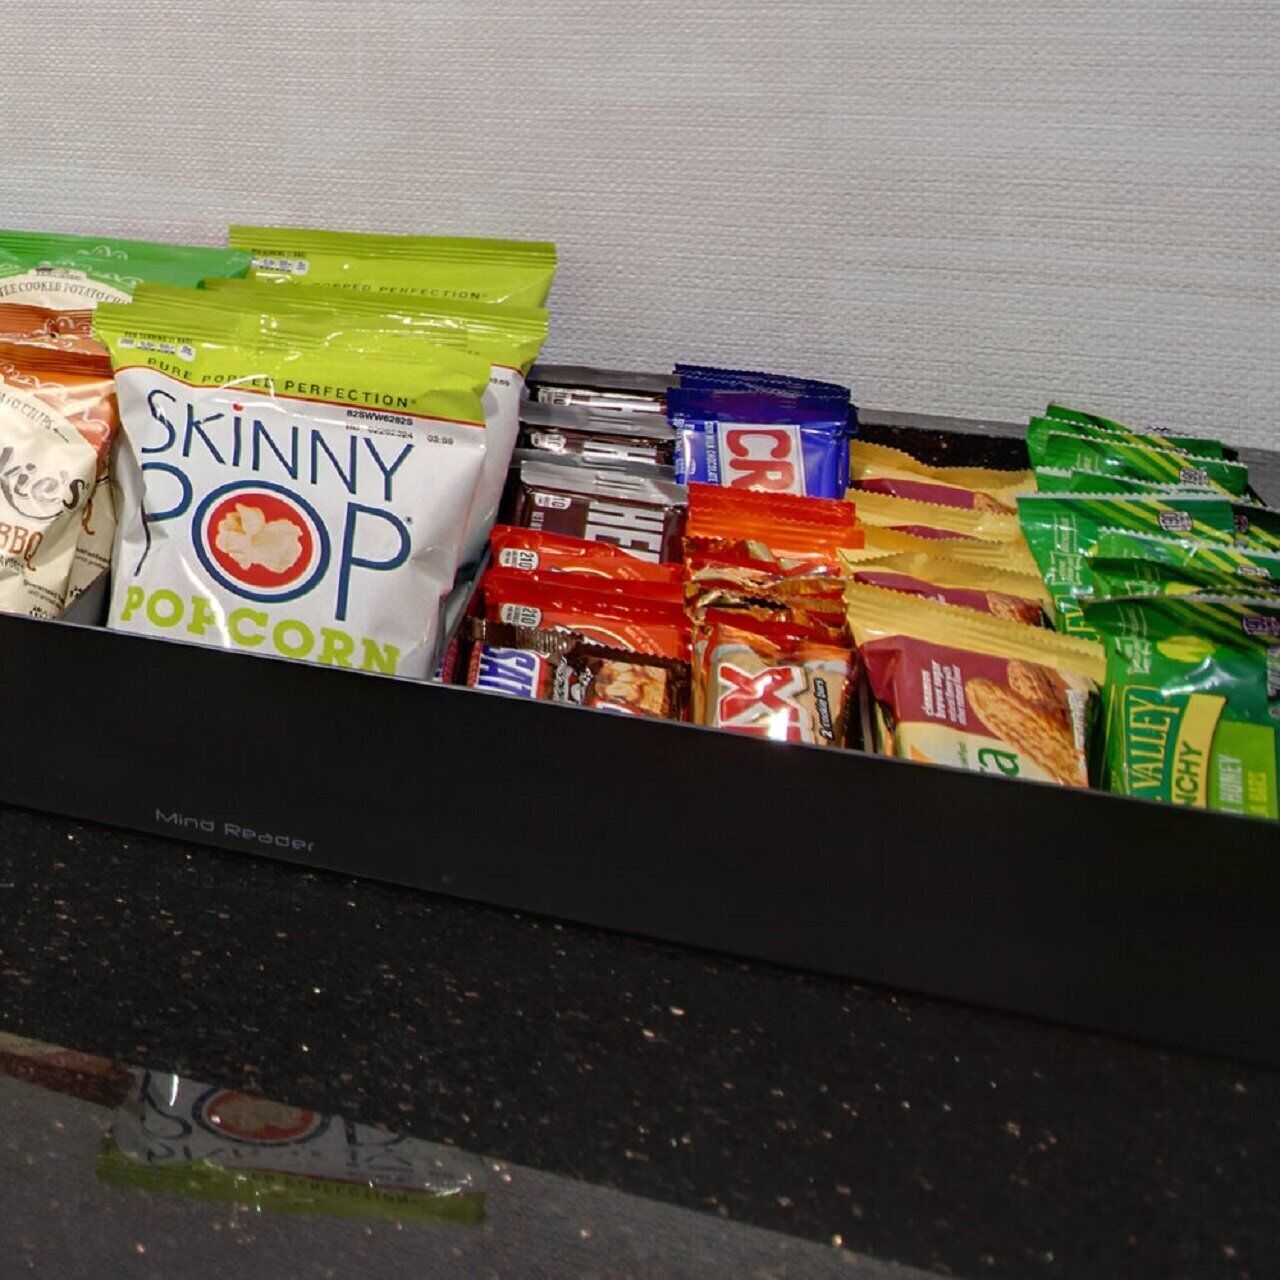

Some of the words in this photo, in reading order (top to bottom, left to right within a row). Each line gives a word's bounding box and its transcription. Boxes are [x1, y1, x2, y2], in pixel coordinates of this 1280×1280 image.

[18, 280, 63, 294] COOKED
[63, 281, 104, 300] POTATO
[147, 357, 194, 382] PURE
[284, 380, 409, 409] PERFECTION
[133, 461, 415, 623] POP
[519, 550, 535, 570] 210
[120, 585, 401, 674] POPCORN
[521, 606, 537, 627] 210
[1129, 693, 1181, 790] VALLEY
[1218, 753, 1244, 805] HONEY
[155, 807, 215, 833] Mind
[223, 821, 316, 853] Reader
